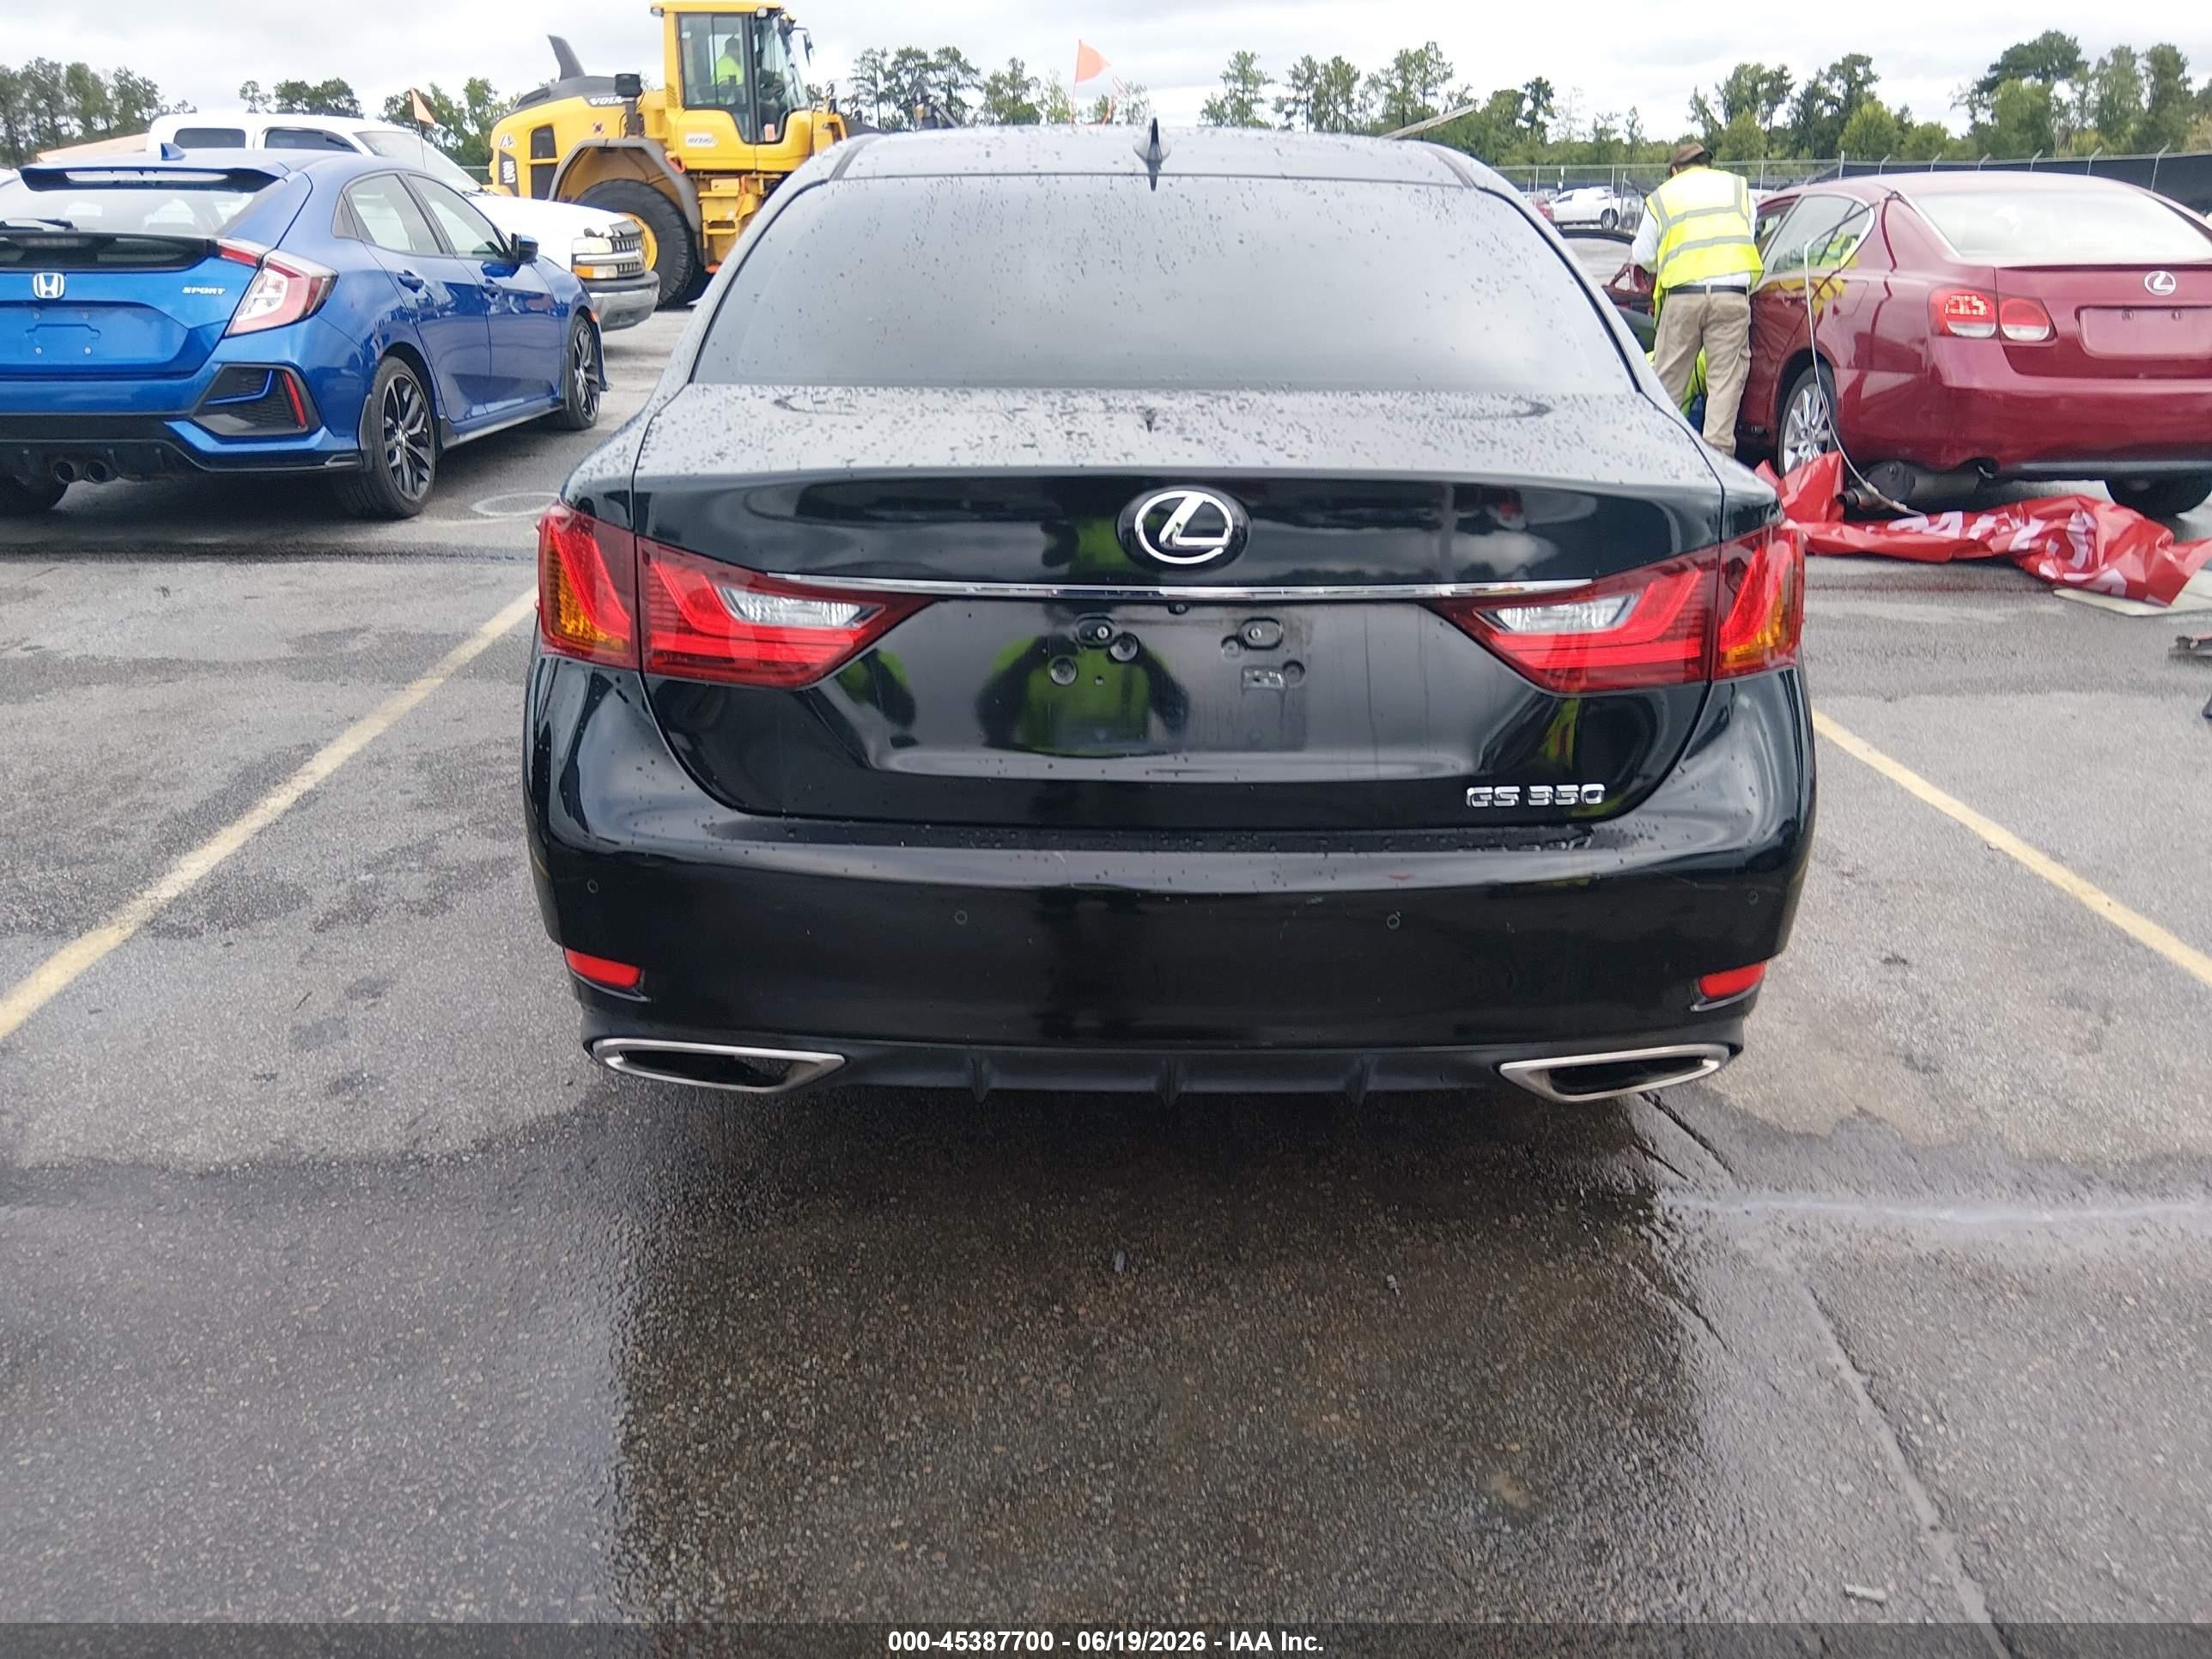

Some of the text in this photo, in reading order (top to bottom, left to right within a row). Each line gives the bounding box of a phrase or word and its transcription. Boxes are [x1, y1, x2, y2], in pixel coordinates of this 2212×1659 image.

[181, 286, 226, 295] SPORT
[1466, 783, 1606, 807] GS 350
